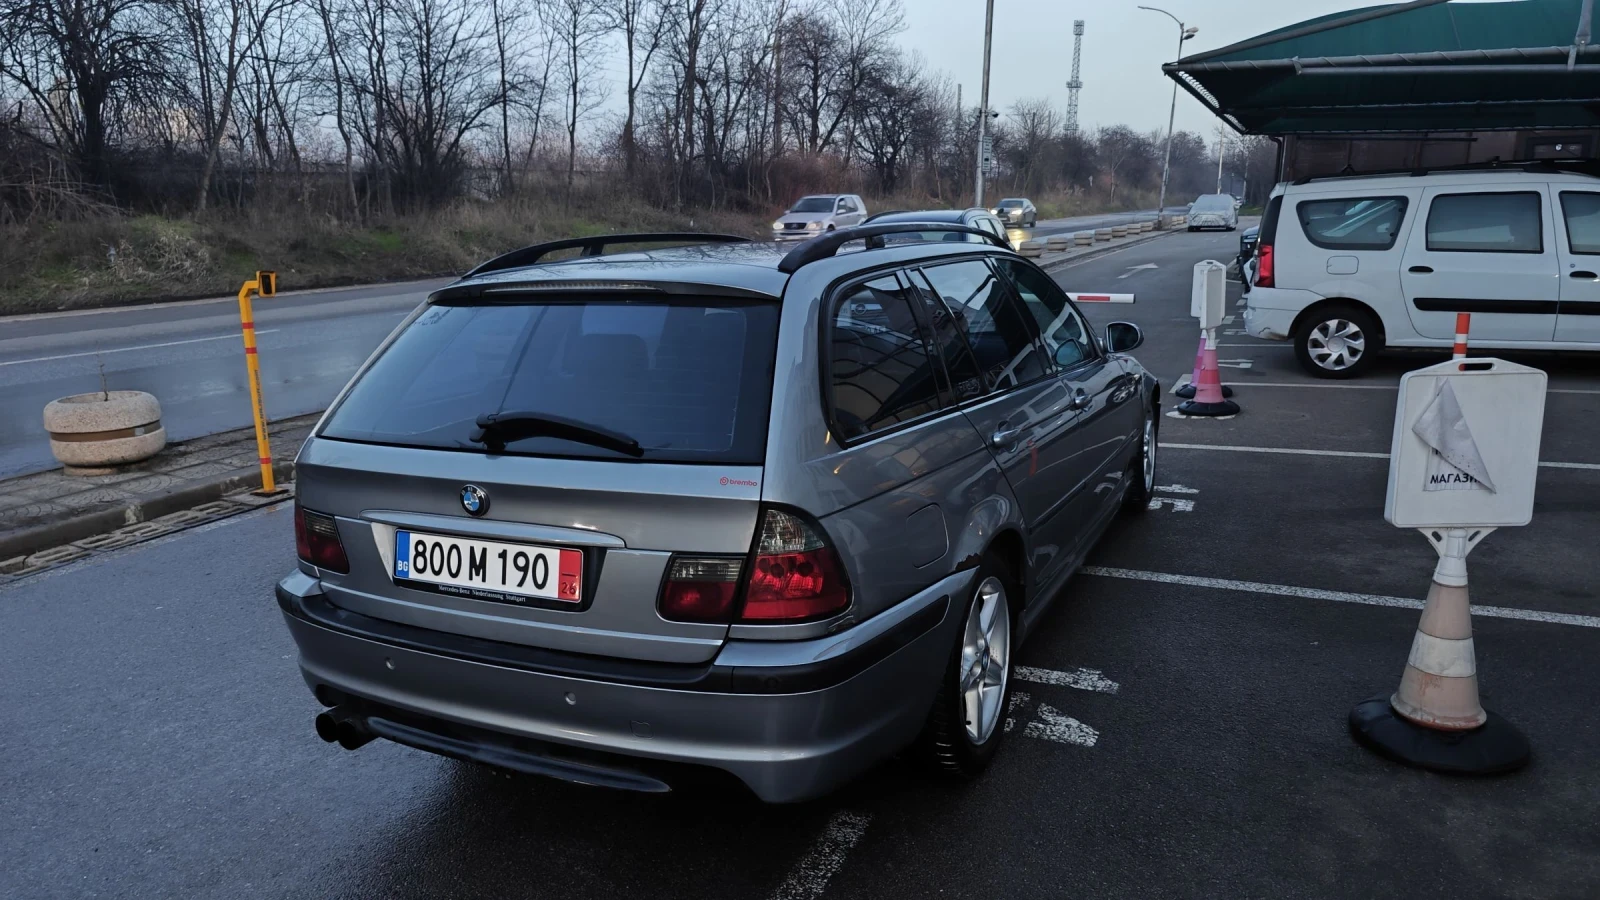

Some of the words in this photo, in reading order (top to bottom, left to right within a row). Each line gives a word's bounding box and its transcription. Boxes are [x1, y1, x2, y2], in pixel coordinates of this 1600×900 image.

[729, 479, 758, 487] brembo
[1430, 473, 1480, 484] МАГАЗИ
[397, 560, 409, 572] BG
[412, 539, 463, 579] 800
[468, 545, 488, 583] M
[498, 549, 550, 590] 190
[438, 584, 470, 595] Mercedes-Benz
[472, 589, 504, 600] Niederlassung
[505, 594, 526, 603] Stuttgart
[561, 582, 577, 595] 26
